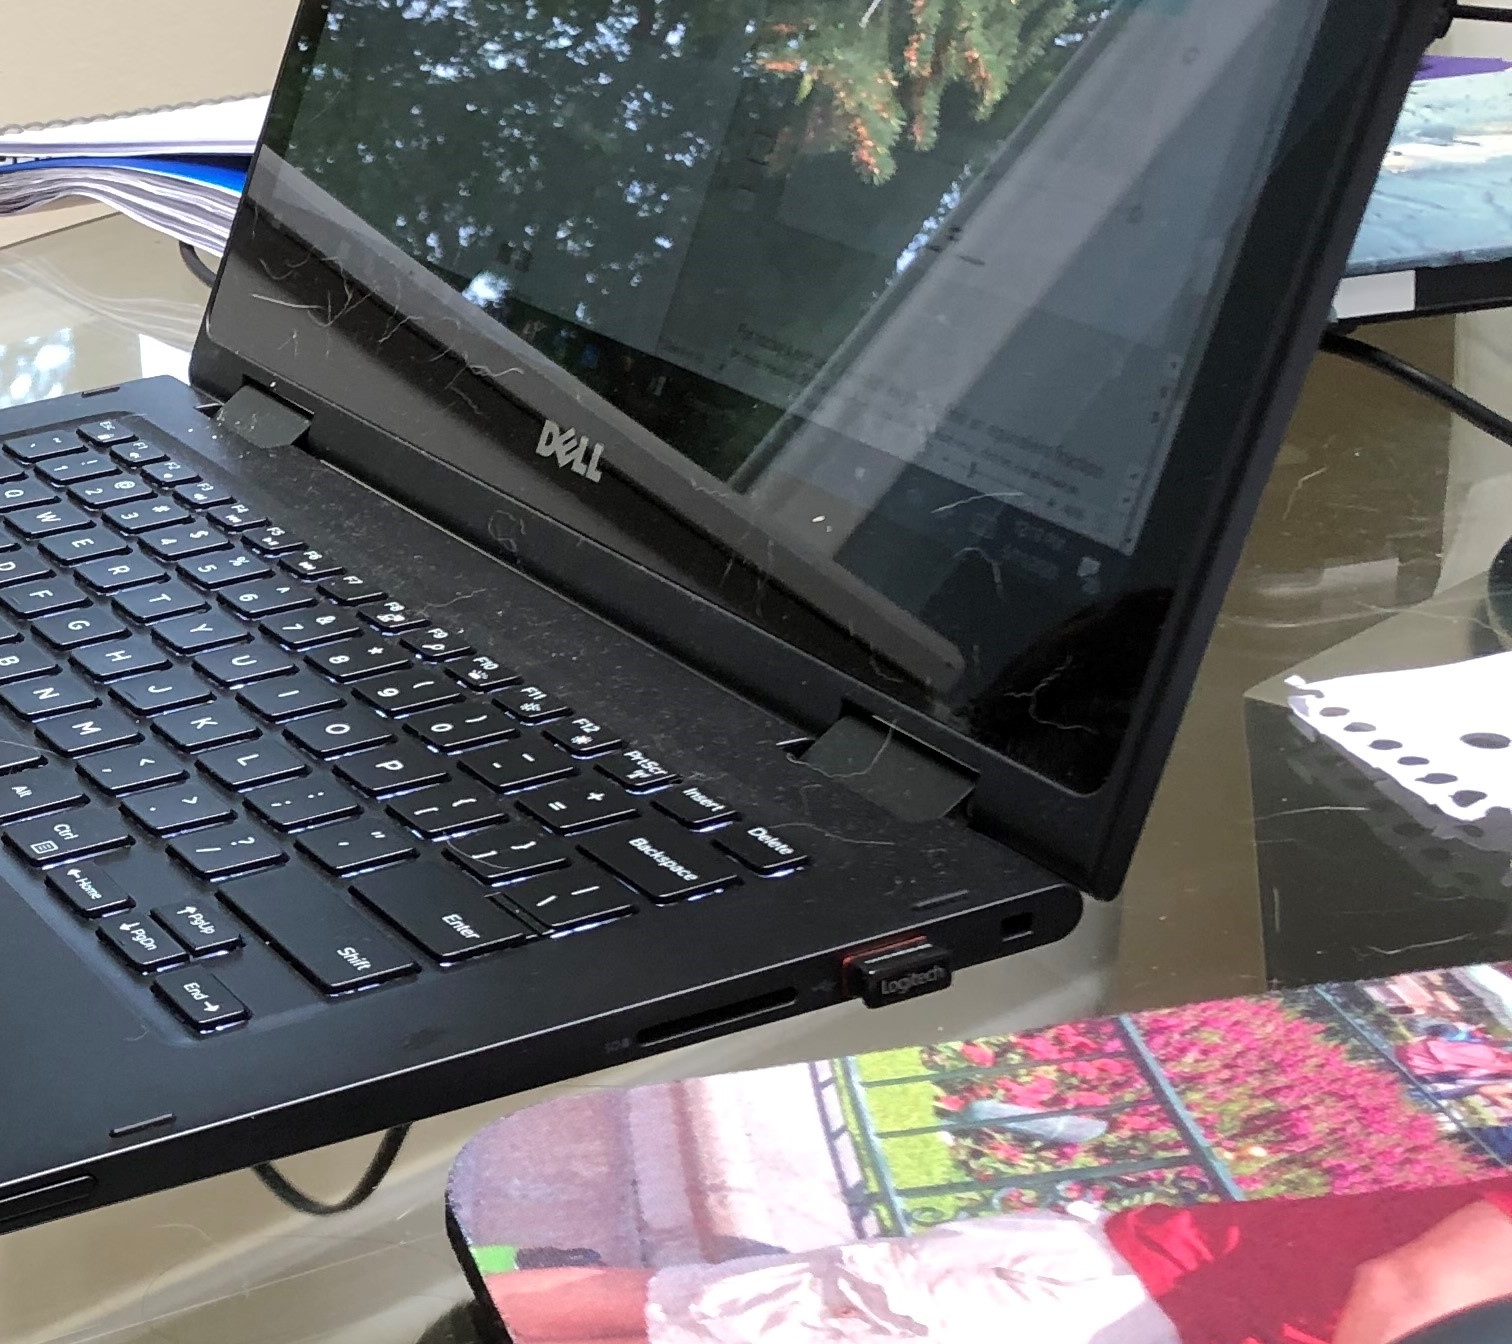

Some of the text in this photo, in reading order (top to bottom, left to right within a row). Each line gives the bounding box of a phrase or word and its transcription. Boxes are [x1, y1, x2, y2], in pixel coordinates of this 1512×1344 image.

[131, 441, 149, 451] F1
[535, 419, 605, 484] DELL
[164, 461, 181, 471] F2
[84, 487, 104, 496] 2
[196, 482, 214, 492] F3
[4, 489, 25, 499] Q
[231, 504, 249, 514] F4
[36, 510, 62, 523] W
[120, 511, 139, 520] 3
[266, 526, 286, 537] F5
[71, 538, 95, 548] E
[160, 538, 178, 546] 4
[302, 550, 323, 561] F6
[107, 565, 131, 576] R
[197, 564, 218, 573] 5
[342, 575, 364, 585] F7
[29, 589, 55, 599] F
[148, 593, 172, 603] T
[238, 593, 259, 602] 6
[383, 601, 405, 612] F8
[67, 620, 91, 631] G
[189, 623, 214, 633] Y
[427, 627, 449, 639] F9
[105, 650, 133, 662] H
[231, 654, 258, 666] U
[328, 655, 351, 664] 8
[472, 656, 499, 670] F10
[32, 687, 60, 700] N
[147, 685, 173, 693] J
[377, 687, 400, 697] 9
[520, 686, 547, 700] F11
[71, 720, 102, 736] M
[190, 716, 219, 730] K
[325, 723, 351, 735] O
[430, 723, 454, 733] 0
[571, 718, 601, 734] F12
[236, 753, 260, 767] L
[375, 759, 404, 771] P
[623, 750, 668, 777] PrtScr
[11, 785, 33, 798] Alt
[682, 787, 726, 813] Insert
[52, 823, 79, 841] Ctrl
[747, 827, 795, 857] Delete
[628, 837, 699, 883] Backspace
[75, 876, 102, 900] Home
[188, 912, 216, 935] PgUp
[441, 913, 481, 939] Enter
[130, 926, 157, 951] PgDn
[336, 946, 372, 971] Shift
[881, 964, 948, 995] Logitech
[183, 982, 209, 1001] End
